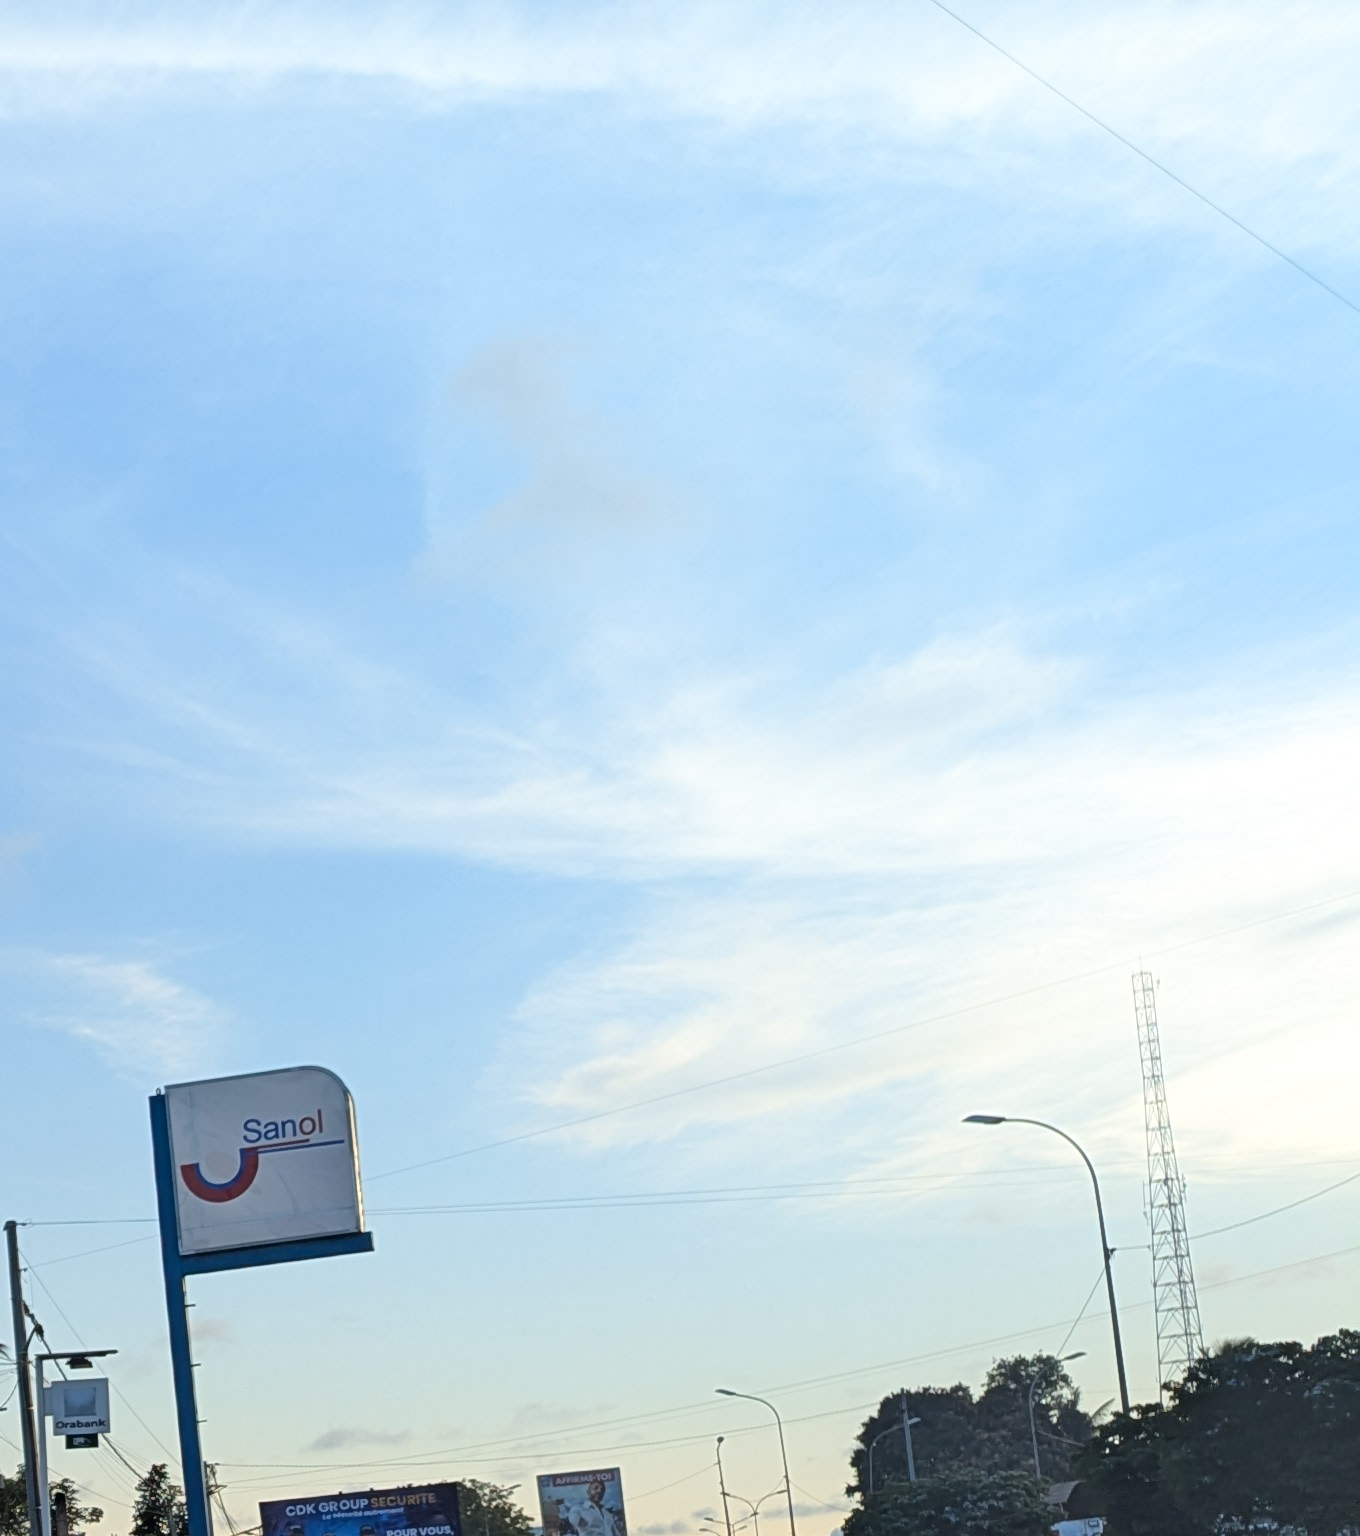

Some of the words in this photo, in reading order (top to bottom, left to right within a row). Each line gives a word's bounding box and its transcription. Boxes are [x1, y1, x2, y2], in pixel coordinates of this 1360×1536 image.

[242, 1108, 324, 1144] Sanol
[55, 1418, 106, 1429] Orabank
[285, 1501, 317, 1517] CDK
[318, 1498, 369, 1513] GROUP
